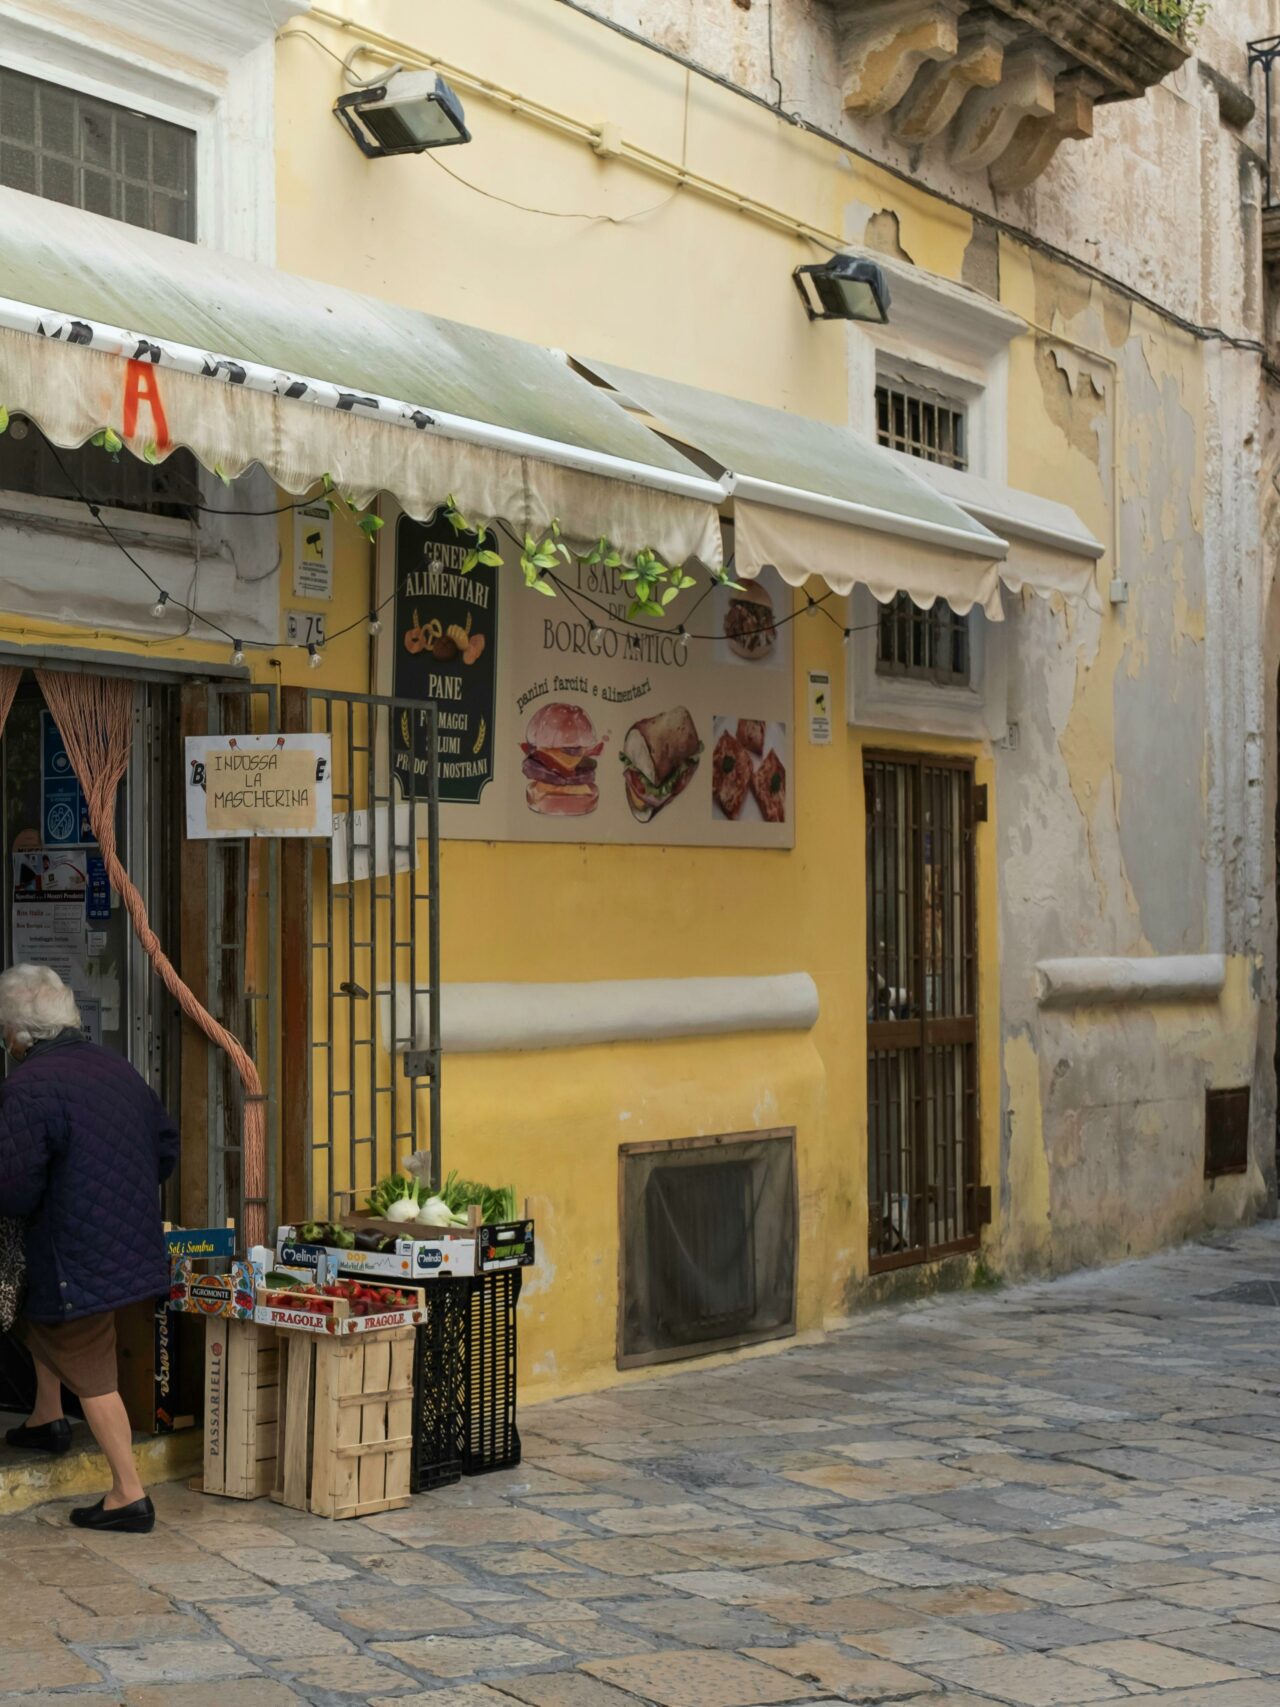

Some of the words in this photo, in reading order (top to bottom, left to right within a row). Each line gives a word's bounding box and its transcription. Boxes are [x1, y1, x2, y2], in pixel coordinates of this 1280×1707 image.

[423, 541, 470, 569] GENER
[405, 571, 490, 609] ALIMENTARI
[305, 616, 326, 646] 75
[543, 618, 618, 658] BORGO
[623, 631, 688, 667] ANTICO
[428, 673, 463, 701] PANE
[516, 678, 549, 714] panini
[553, 675, 588, 693] farciti
[592, 685, 598, 696] e
[601, 677, 652, 703] alimentari
[419, 709, 468, 731] FMAGGI
[214, 754, 278, 772] INDOSSA
[442, 758, 488, 779] NOSTRANI
[245, 773, 261, 788] LA
[214, 788, 309, 808] MASCHERINA
[282, 1249, 318, 1264] Melind
[191, 1287, 230, 1299] AGROMONTE
[271, 1311, 323, 1328] FRAGOLE
[364, 1313, 405, 1329] FRAGOLE
